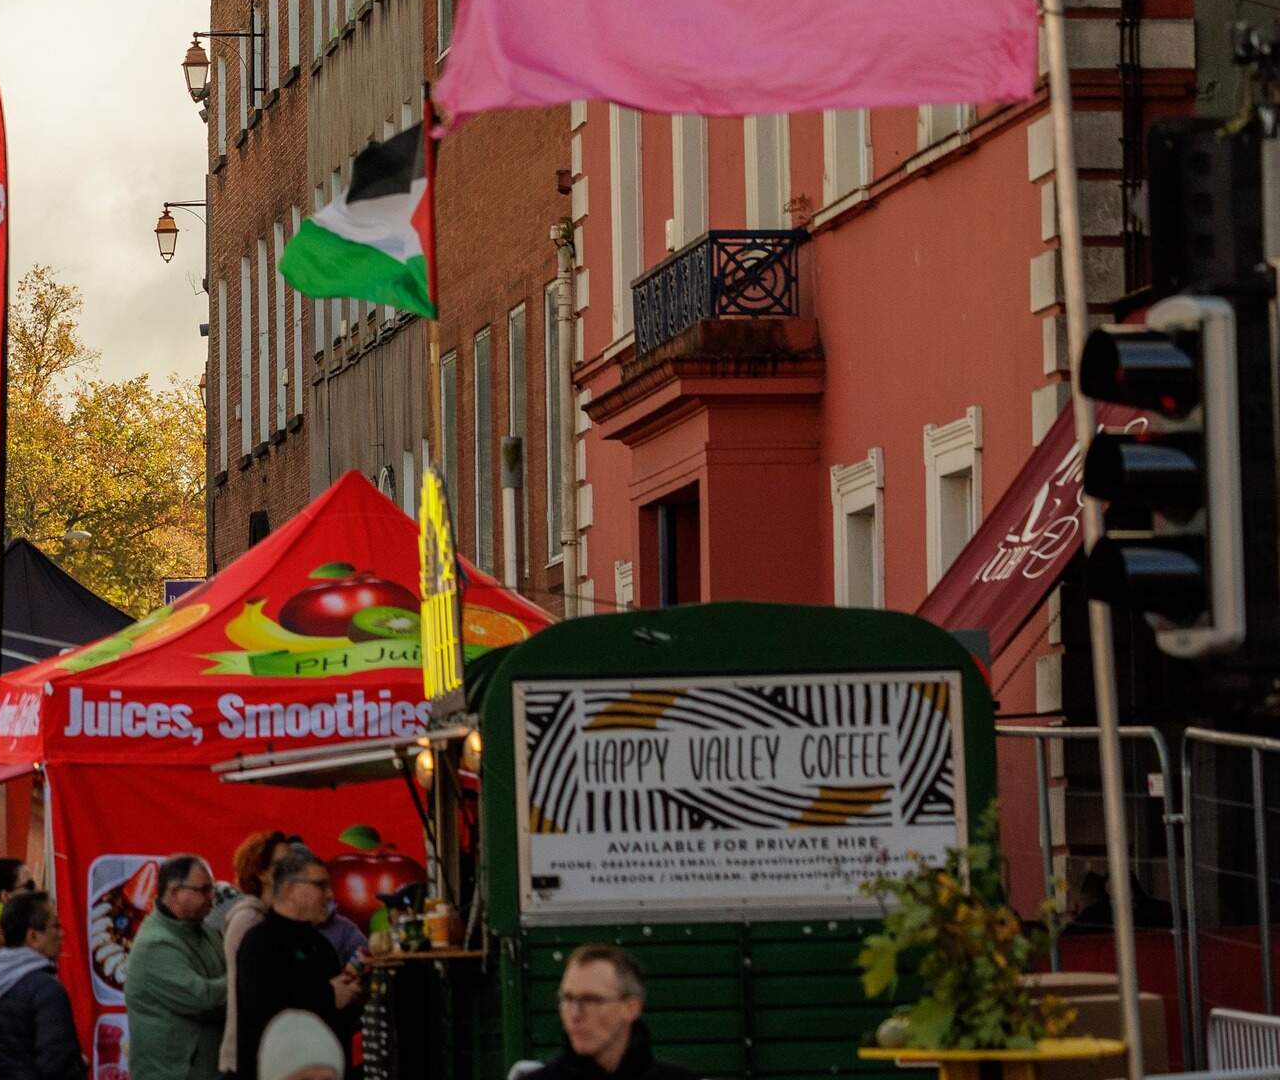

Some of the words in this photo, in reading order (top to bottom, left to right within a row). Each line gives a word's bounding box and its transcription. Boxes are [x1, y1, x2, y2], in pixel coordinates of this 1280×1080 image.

[296, 653, 348, 675] PH
[364, 644, 421, 664] Jui
[64, 686, 204, 745] Juices,
[218, 689, 432, 739] Smoothies
[584, 736, 669, 784] HAPPY
[690, 734, 780, 782] VALLEY
[800, 731, 891, 779] COFFEE
[607, 839, 706, 855] AVAILABLE
[714, 838, 747, 852] FOR
[756, 837, 829, 851] PRIVATE
[837, 836, 880, 849] HIRE
